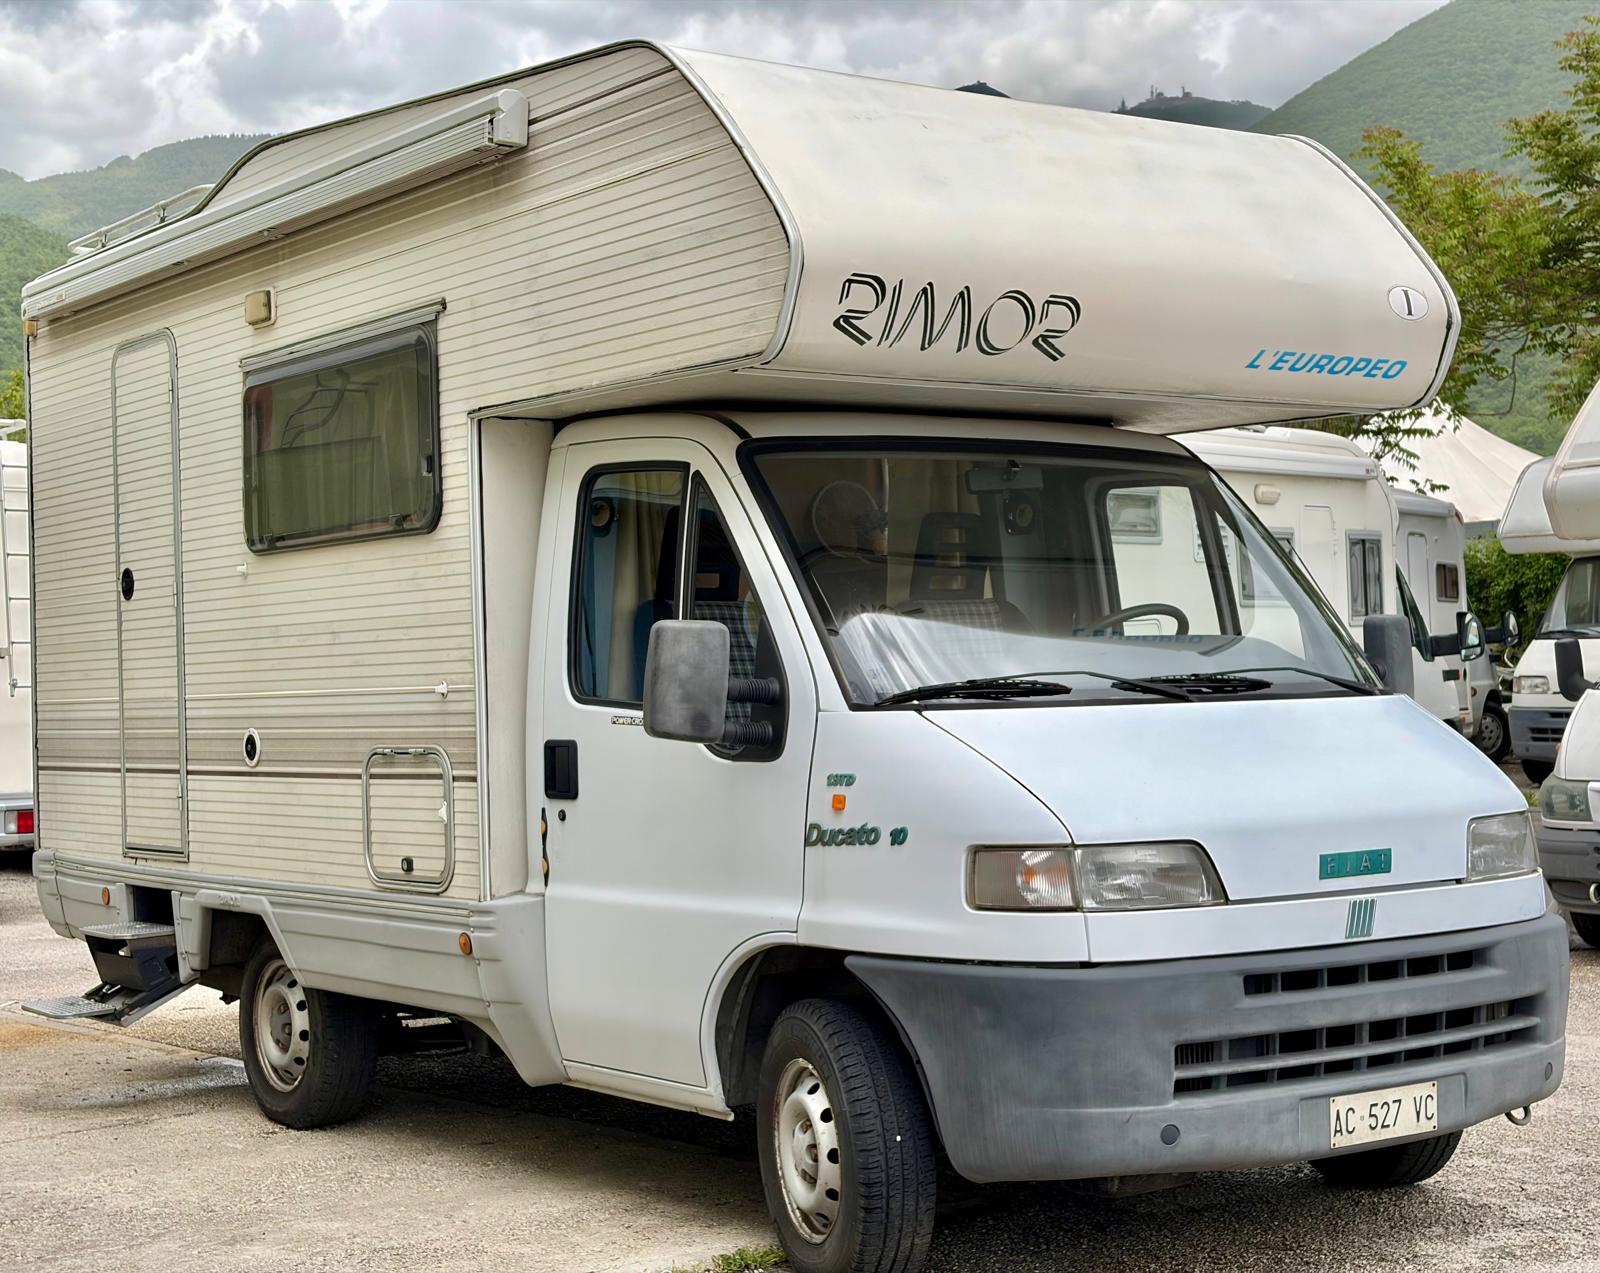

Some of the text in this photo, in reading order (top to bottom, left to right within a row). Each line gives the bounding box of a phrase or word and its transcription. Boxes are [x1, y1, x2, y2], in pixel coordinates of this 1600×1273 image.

[832, 272, 1081, 362] RIMOR
[1245, 350, 1408, 379] L'EUROPEO
[805, 822, 909, 847] Ducato 10
[1327, 853, 1387, 874] FIAT
[1333, 1094, 1435, 1137] AC 527 VC
